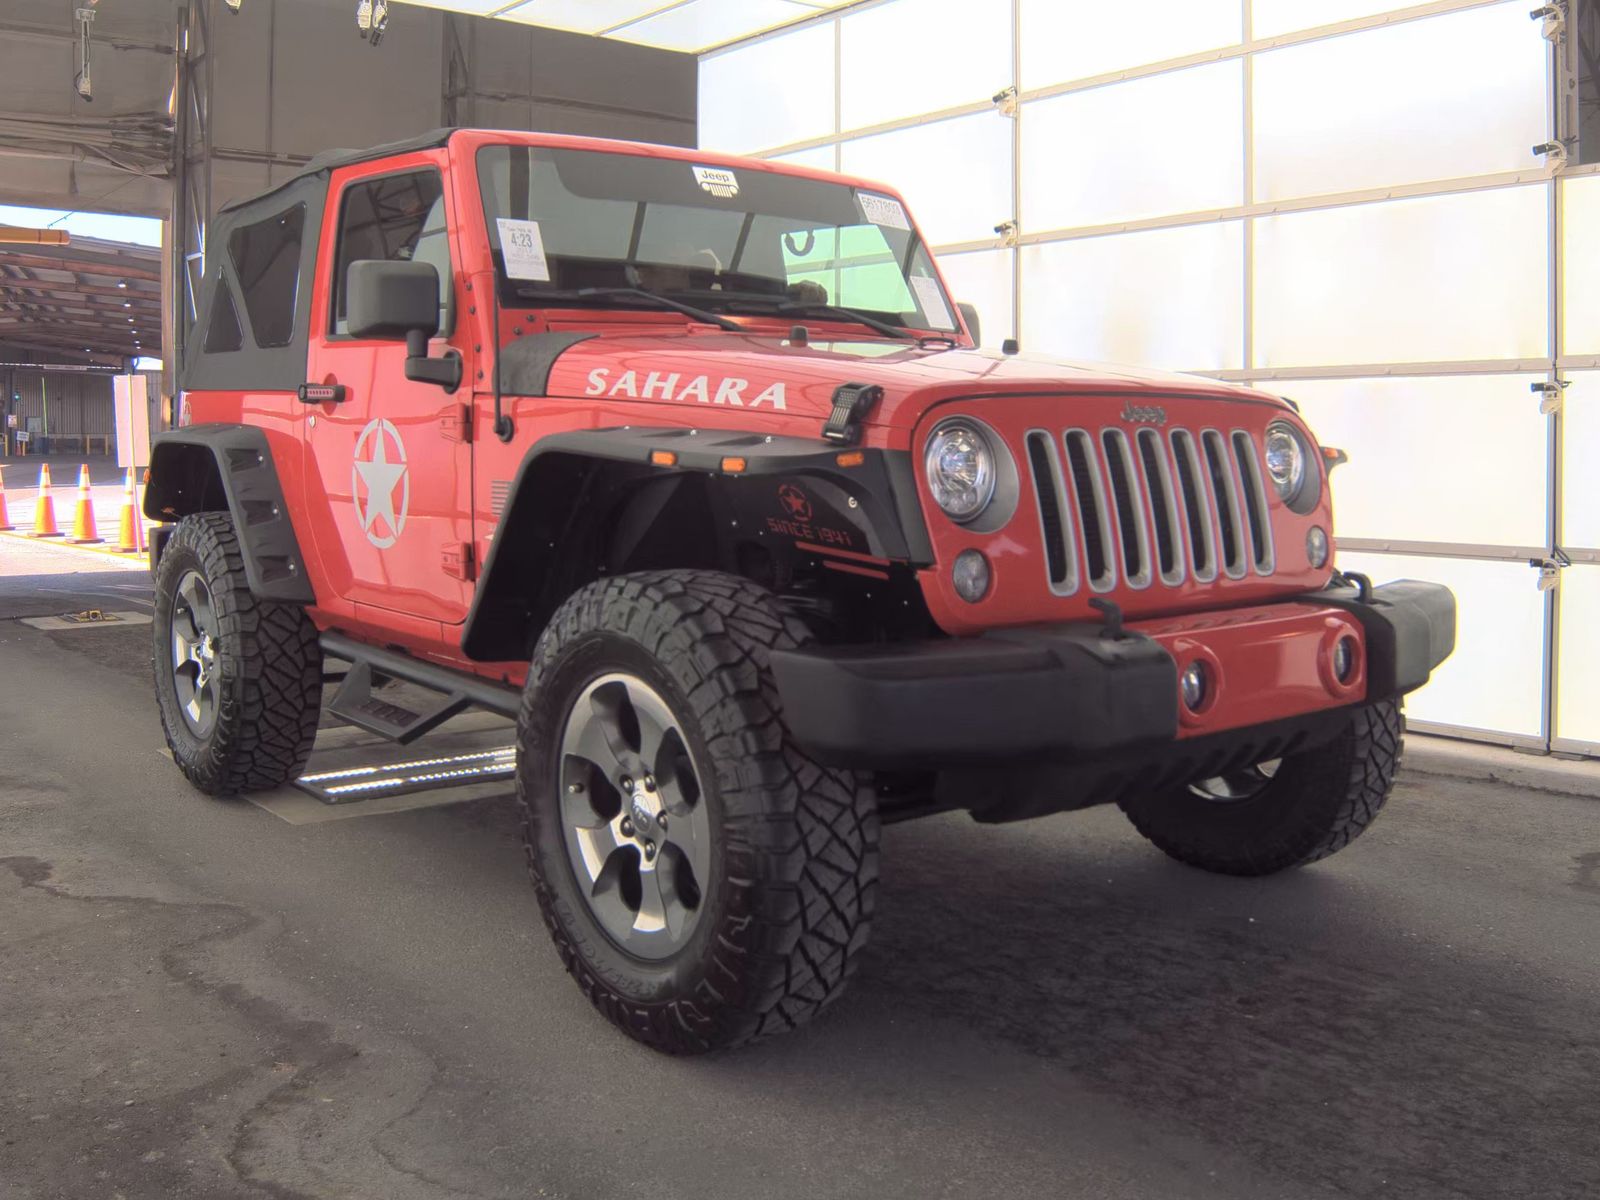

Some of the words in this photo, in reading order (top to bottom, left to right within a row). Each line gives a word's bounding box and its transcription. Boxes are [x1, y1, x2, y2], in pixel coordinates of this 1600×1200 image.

[702, 169, 730, 183] Jeep
[585, 367, 787, 411] SAHARA
[1120, 399, 1167, 427] Jeep
